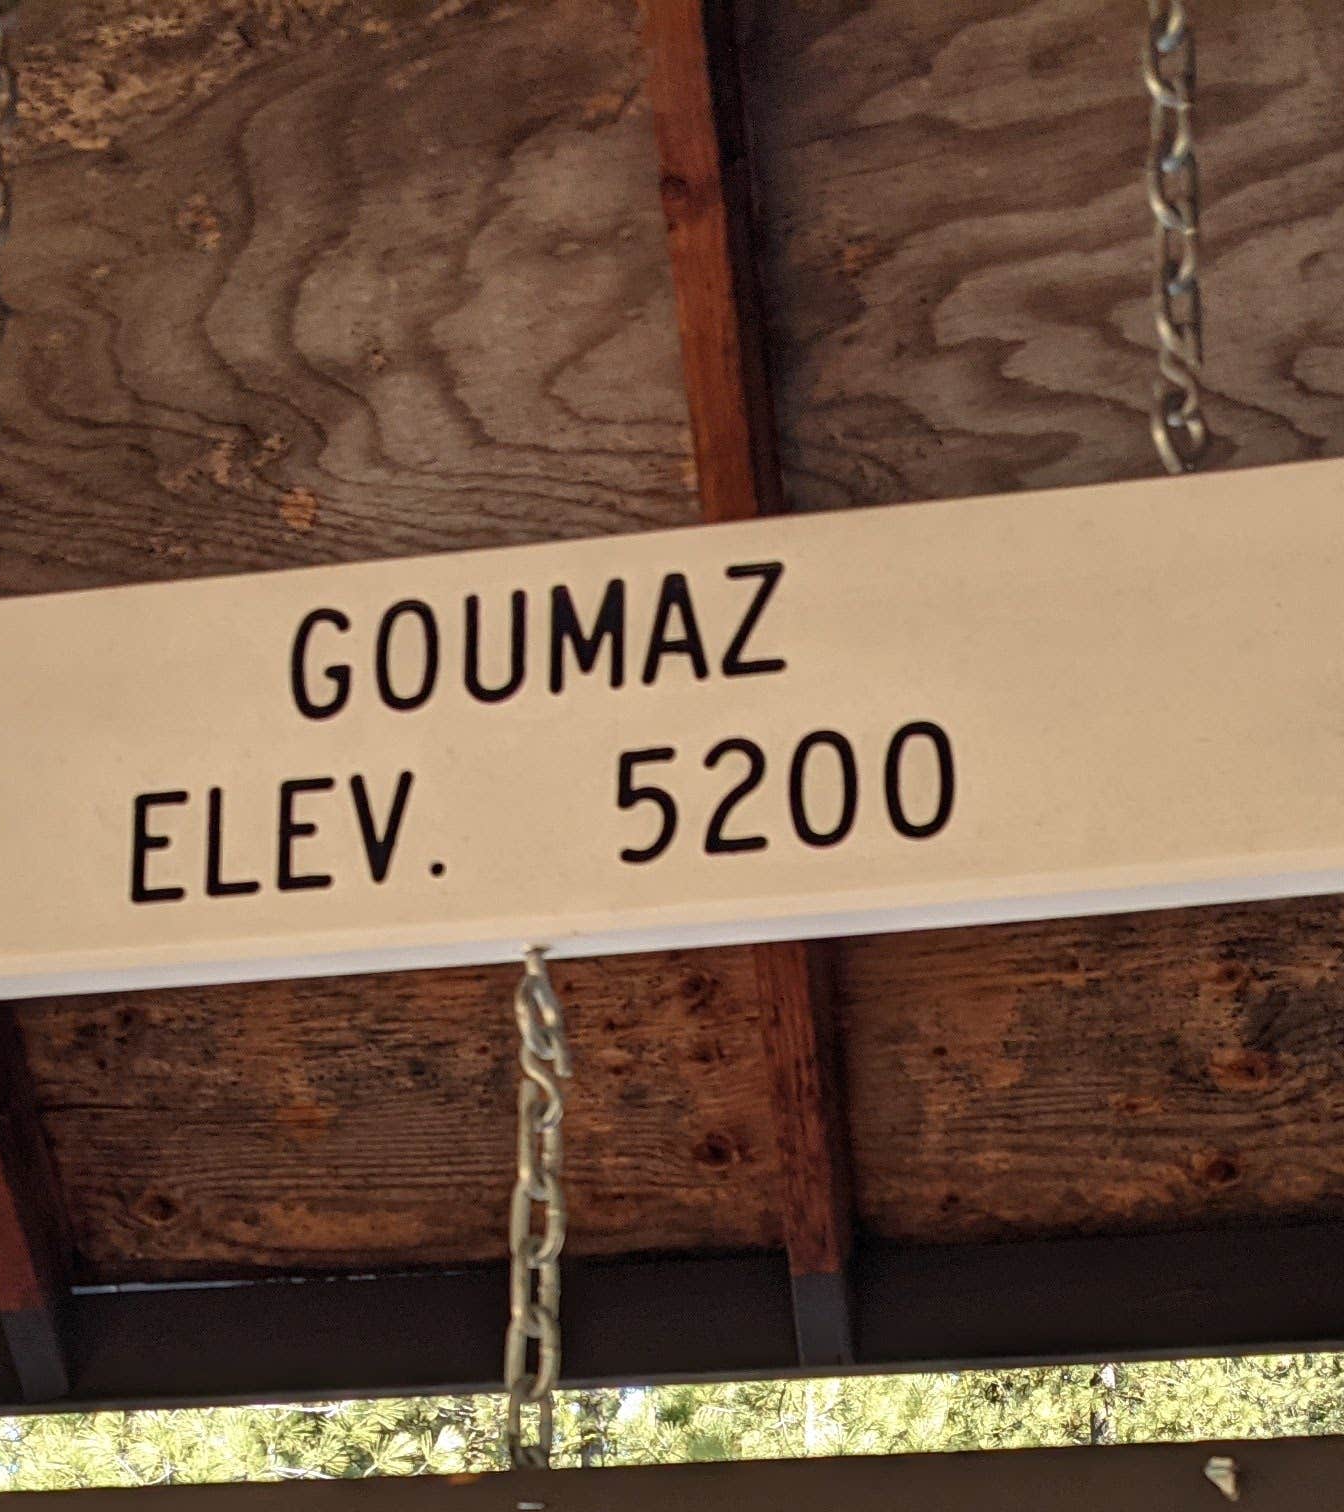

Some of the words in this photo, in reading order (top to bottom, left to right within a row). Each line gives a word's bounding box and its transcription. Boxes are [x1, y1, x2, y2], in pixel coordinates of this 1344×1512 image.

[290, 560, 787, 720] GOUMAZ
[130, 770, 444, 904] ELEV.
[616, 720, 955, 864] 5200
